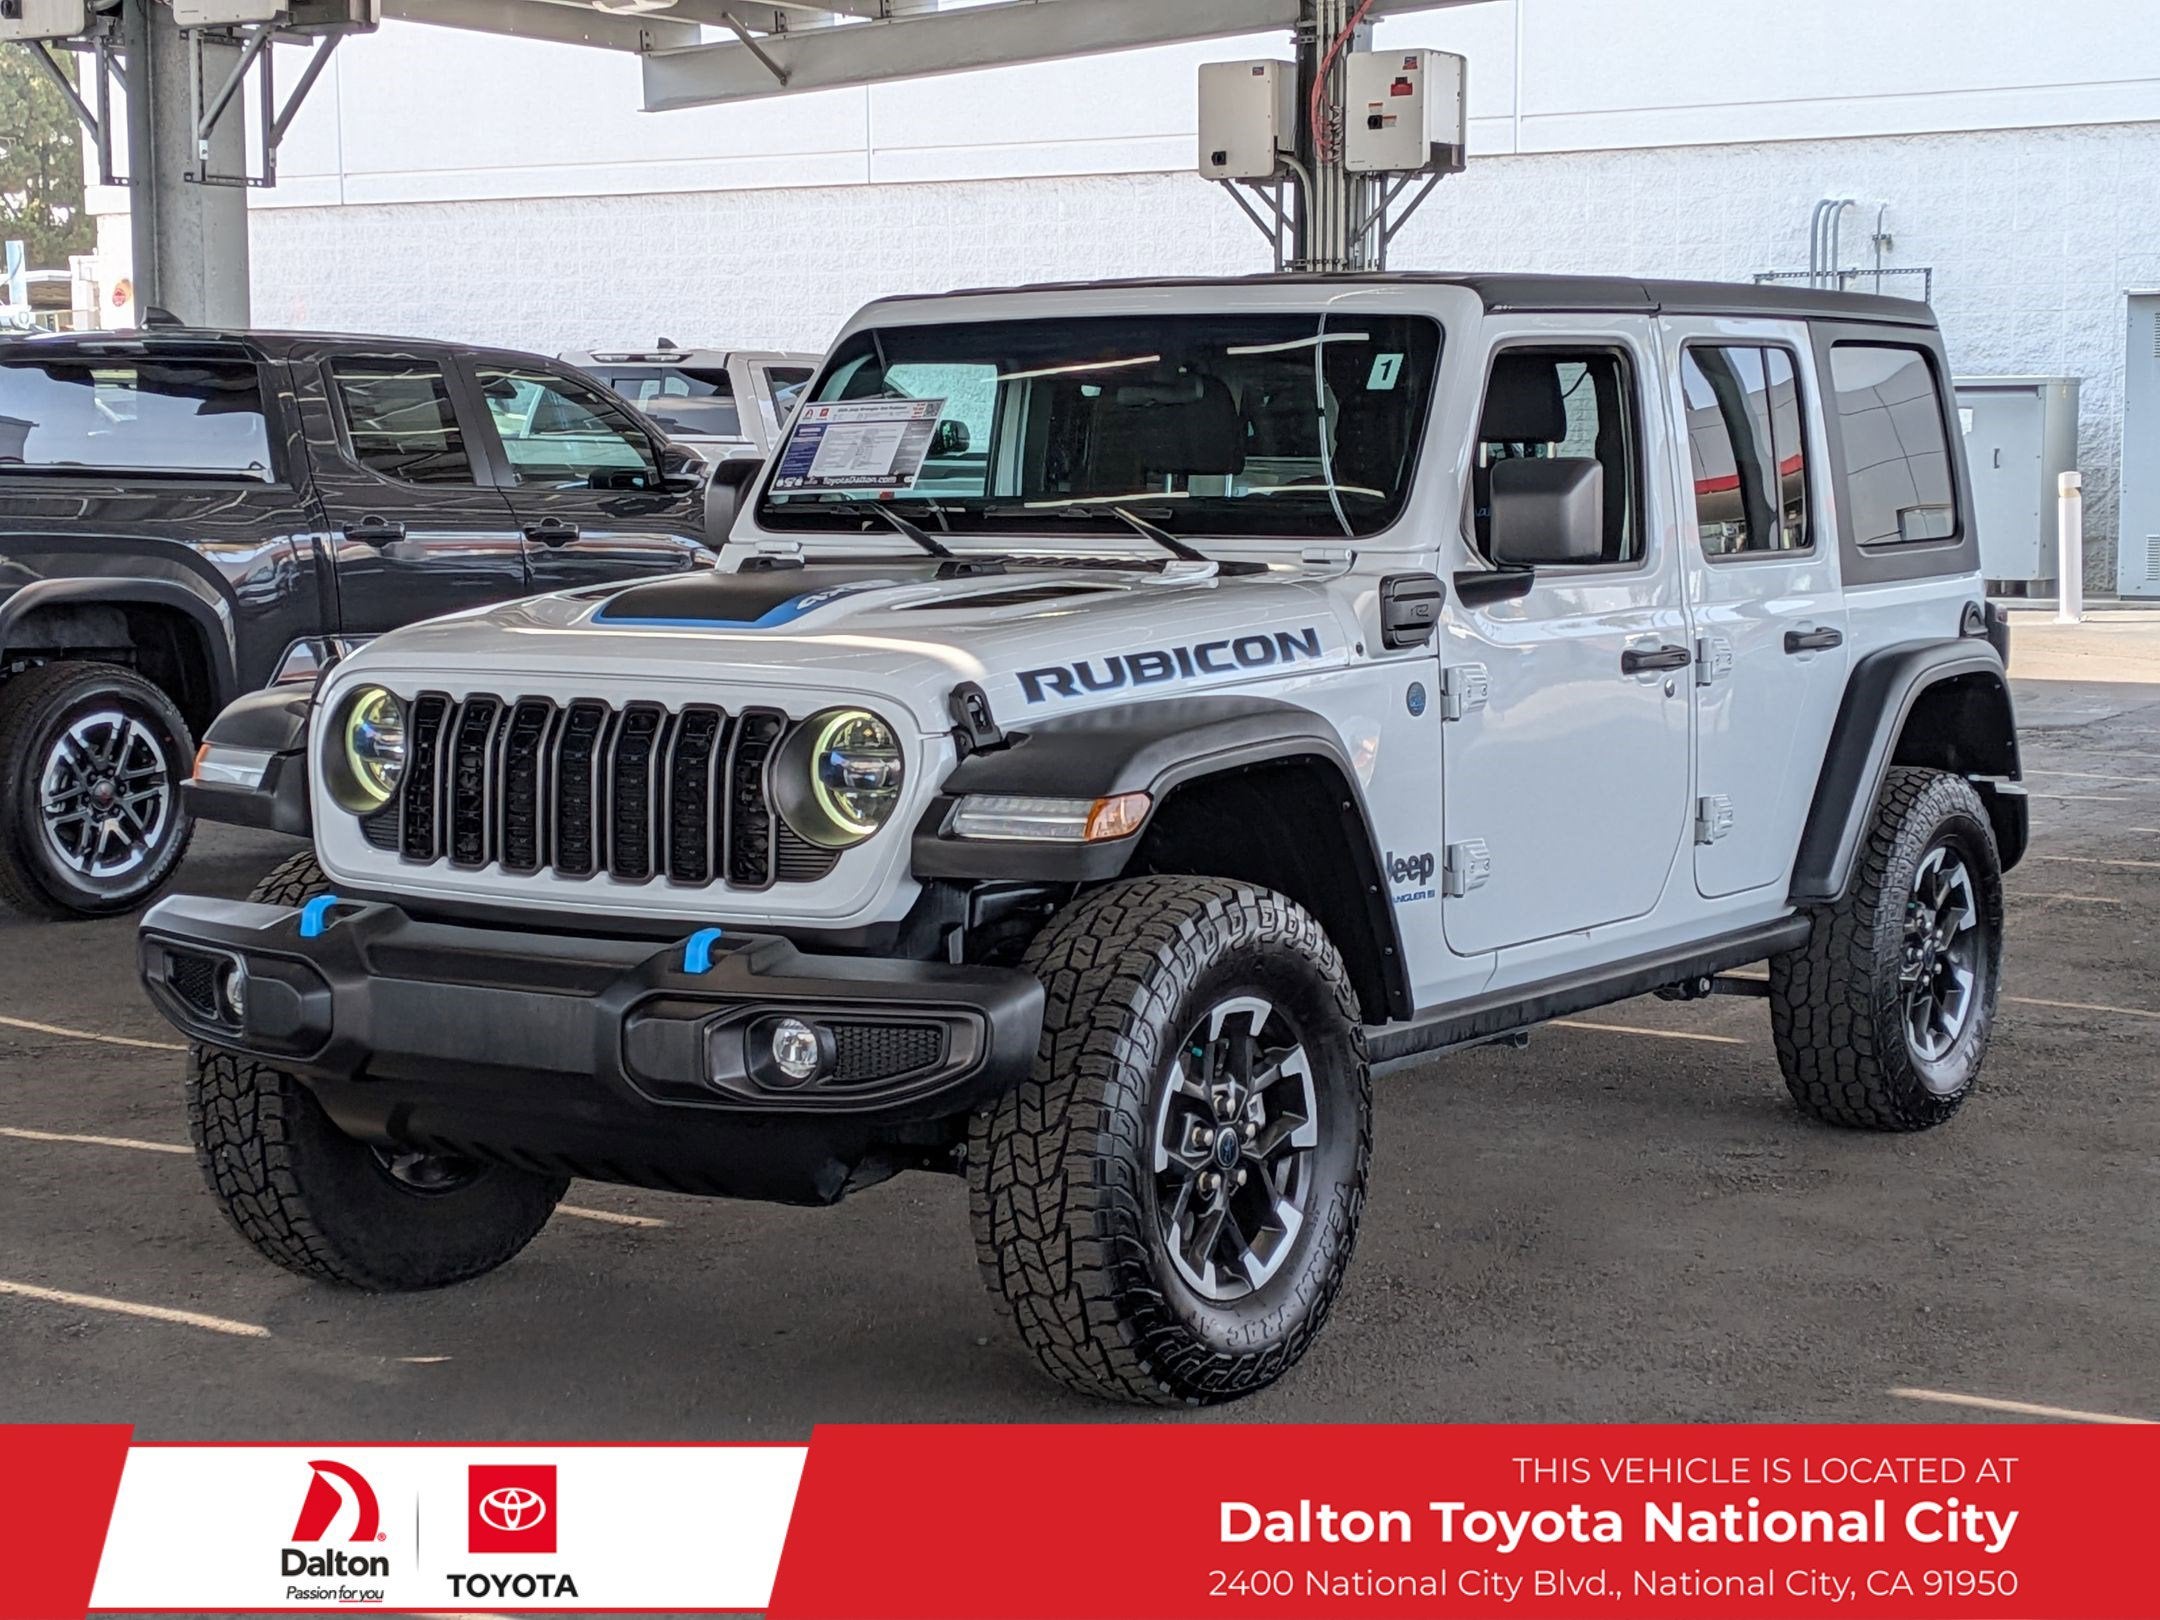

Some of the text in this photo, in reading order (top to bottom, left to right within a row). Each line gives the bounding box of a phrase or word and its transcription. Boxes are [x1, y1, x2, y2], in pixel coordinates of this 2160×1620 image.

[1381, 359, 1393, 381] 1
[1015, 627, 1322, 705] RUBICON
[1386, 851, 1435, 887] Jeep
